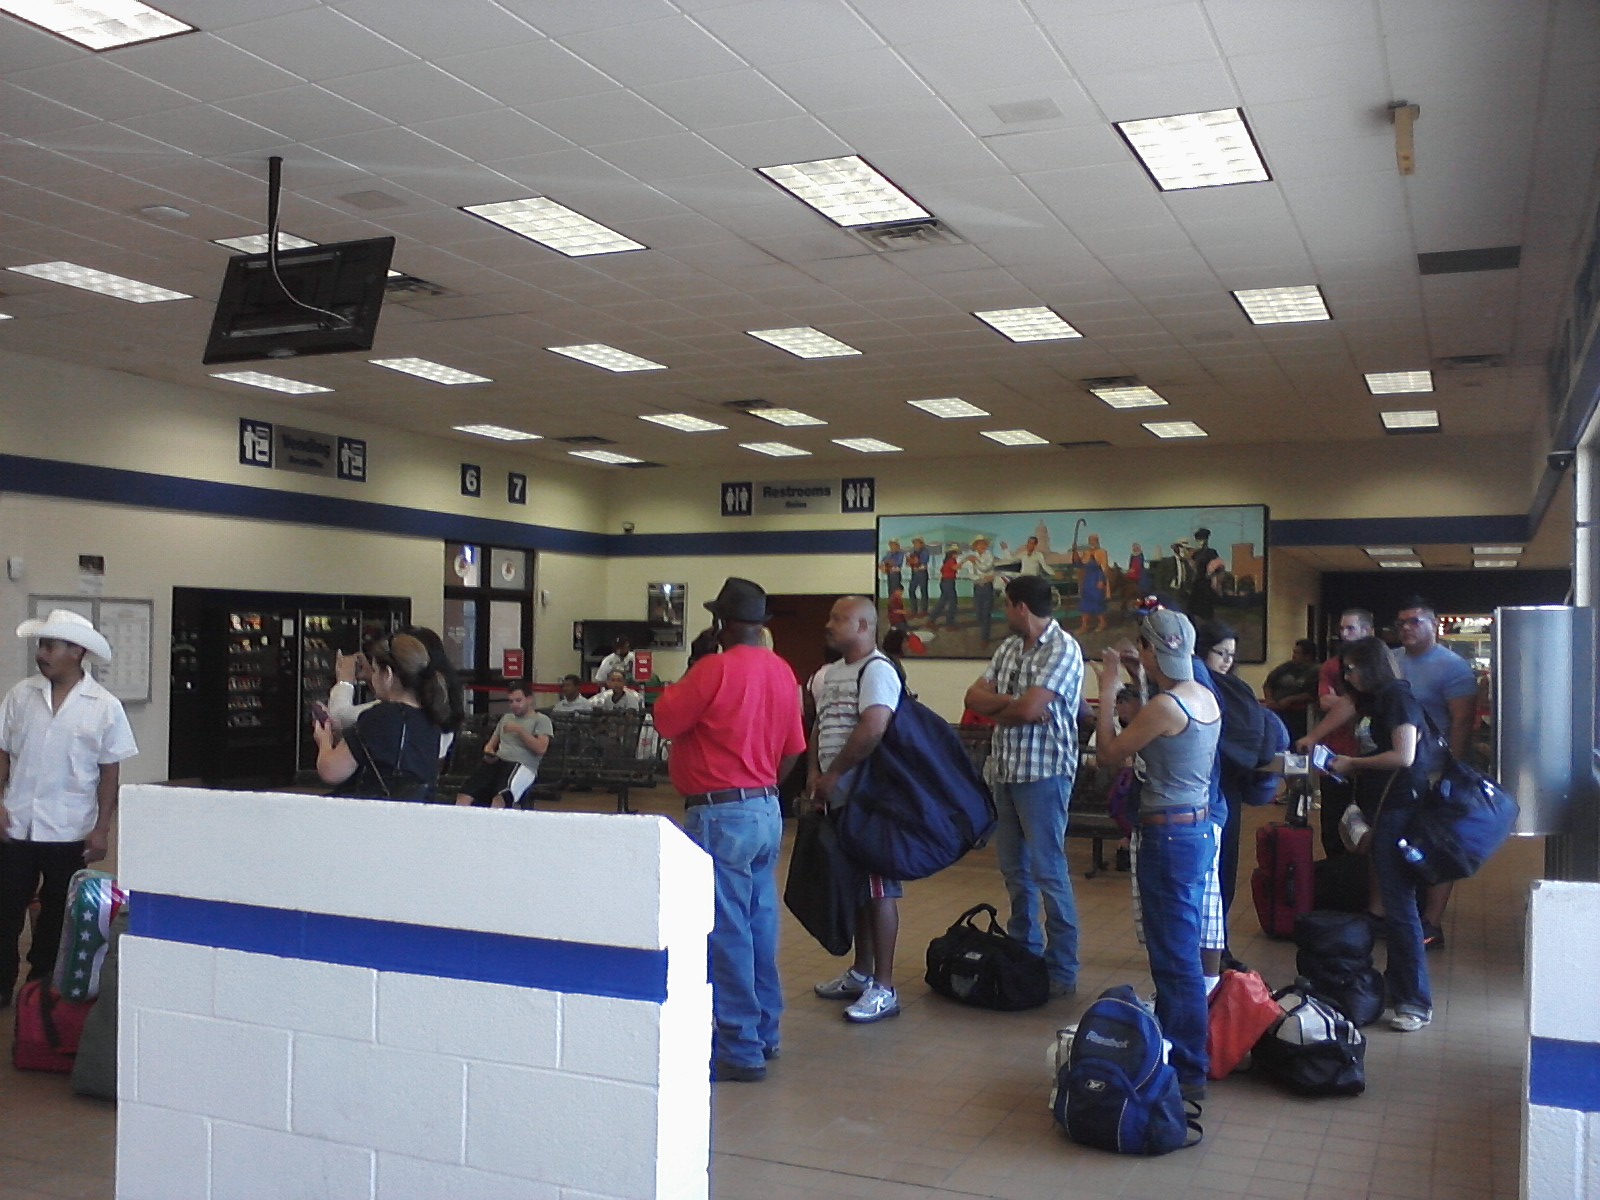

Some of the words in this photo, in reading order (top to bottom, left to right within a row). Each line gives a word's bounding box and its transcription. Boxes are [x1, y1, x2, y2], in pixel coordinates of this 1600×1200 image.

[465, 469, 478, 492] 6
[514, 478, 523, 500] 7
[762, 486, 832, 498] Restrooms
